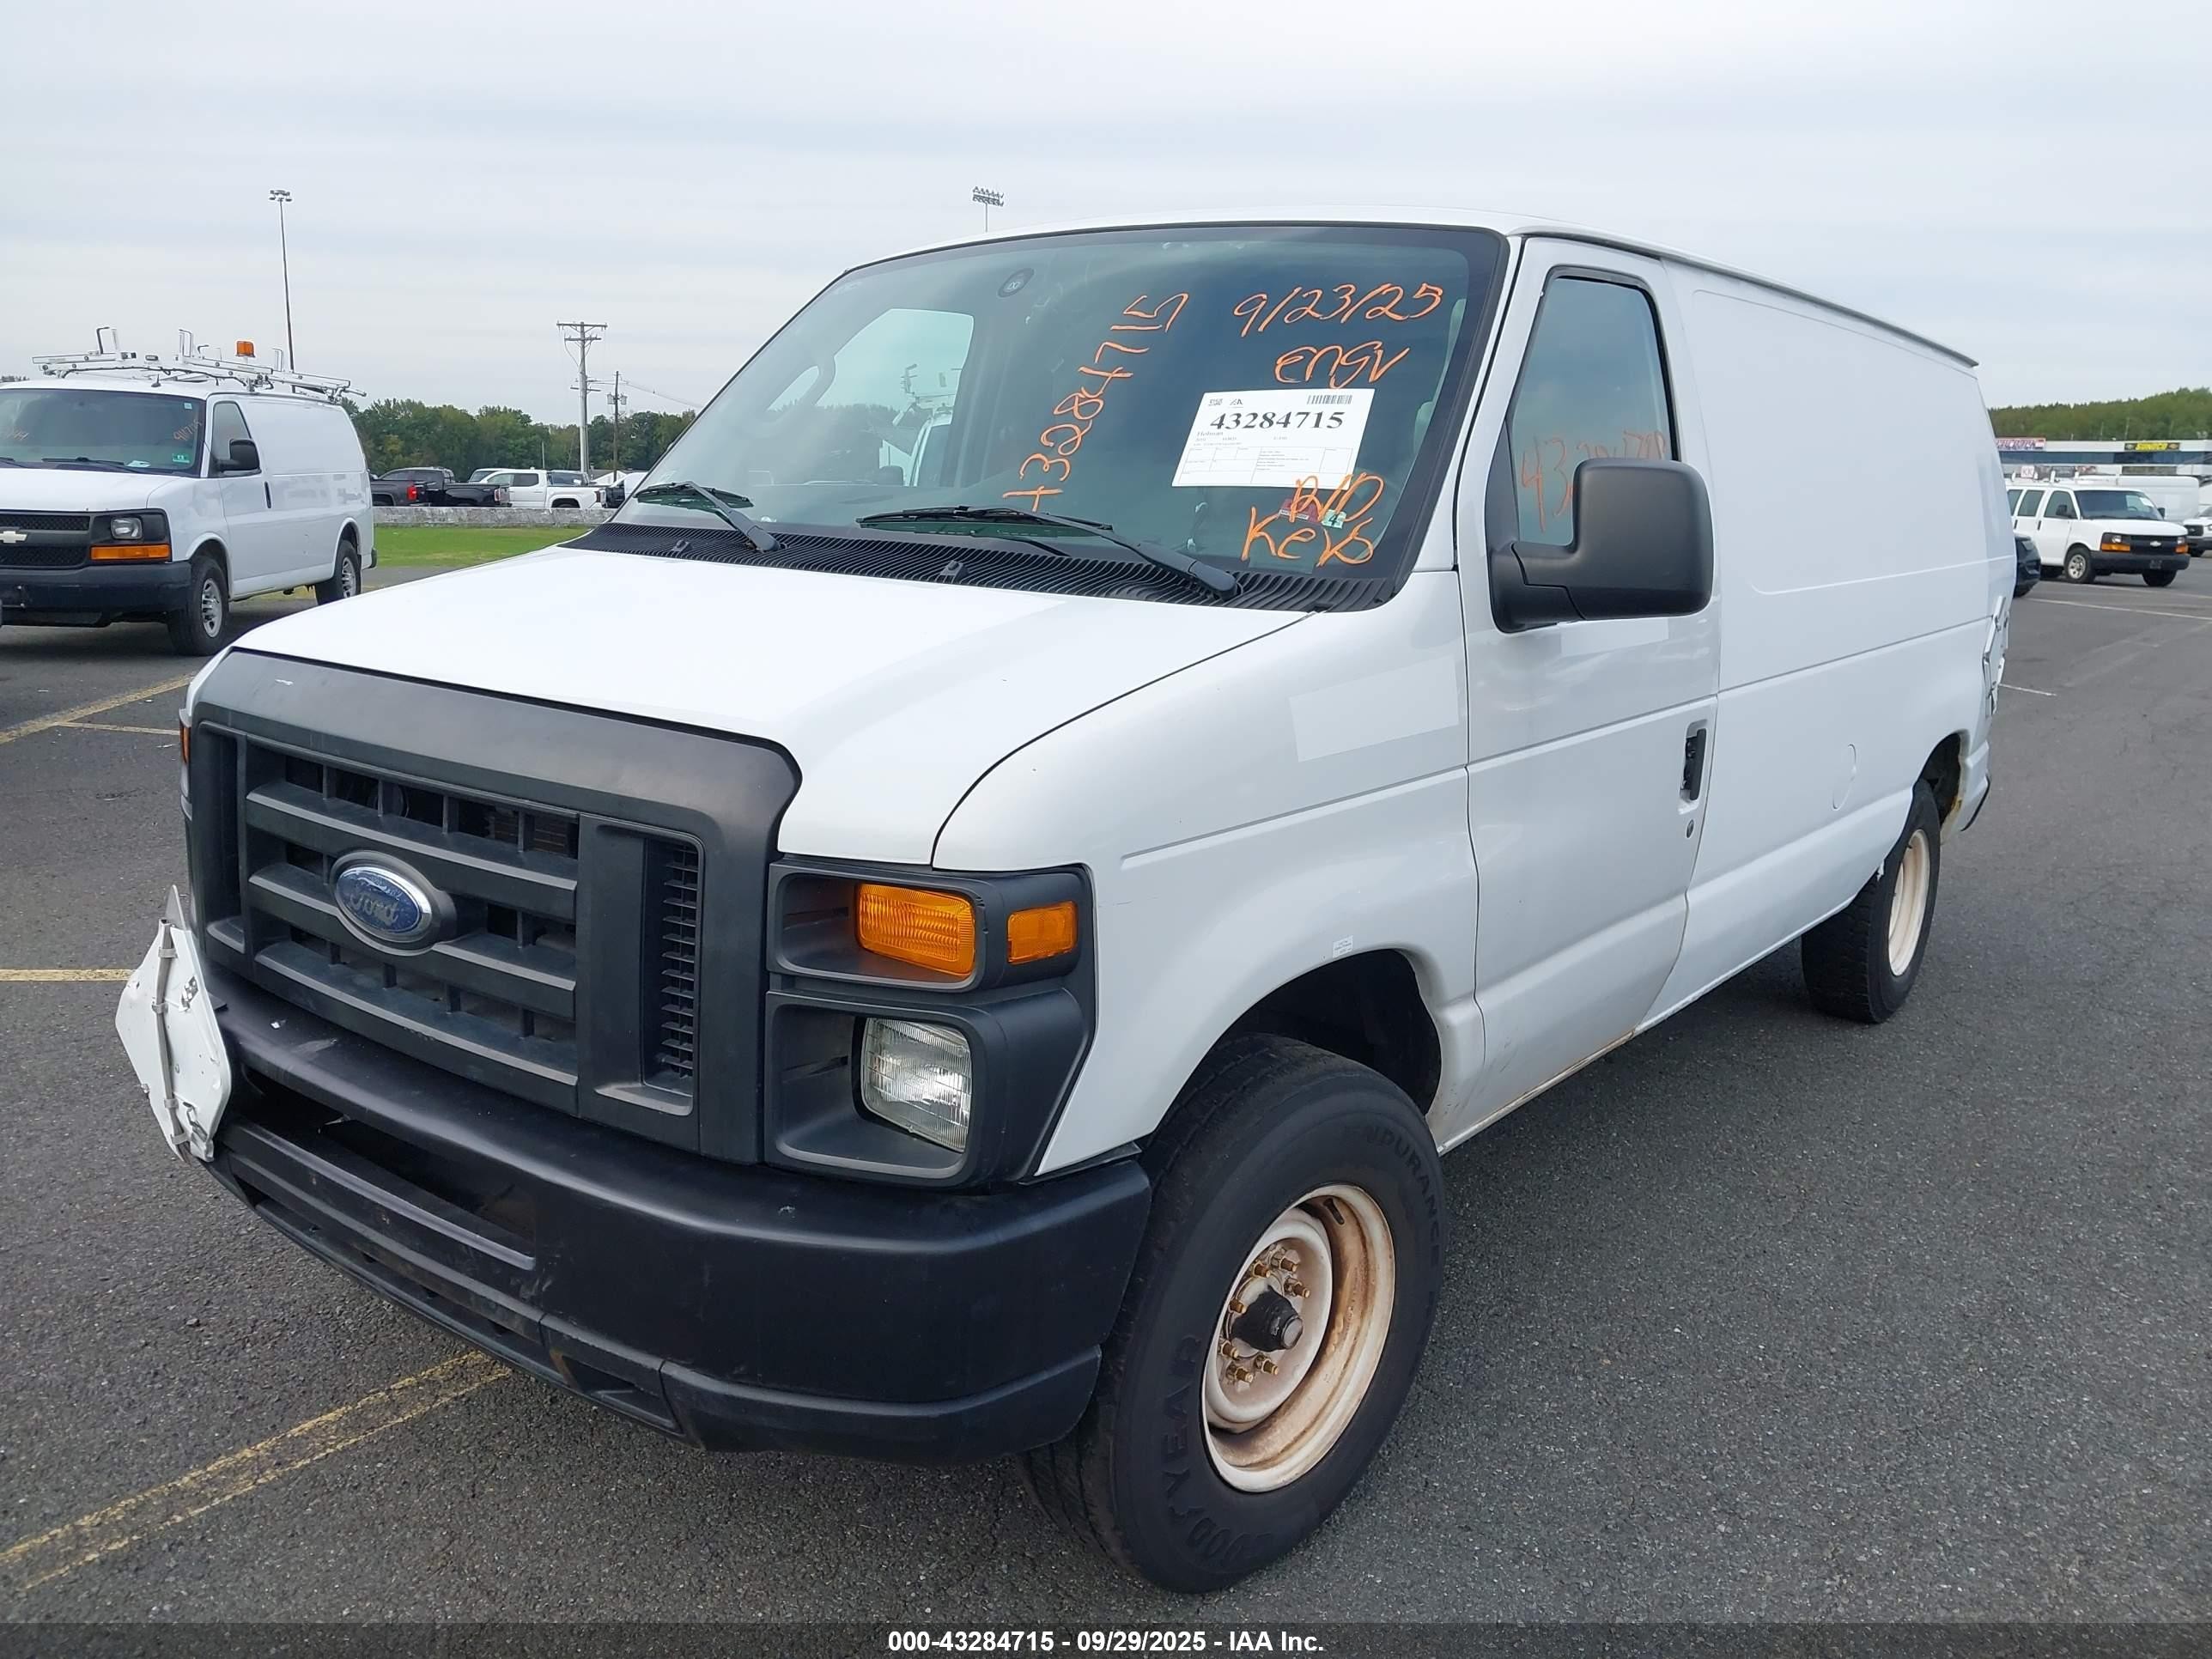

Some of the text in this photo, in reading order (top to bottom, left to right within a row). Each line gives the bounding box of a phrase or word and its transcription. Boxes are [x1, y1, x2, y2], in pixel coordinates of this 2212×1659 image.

[1234, 283, 1443, 337] 9/23/25
[1002, 292, 1190, 513] 43284715
[1210, 410, 1346, 430] 43284715
[1241, 506, 1375, 568] Keys
[1328, 514, 1339, 526] 4
[349, 878, 403, 926] Ford
